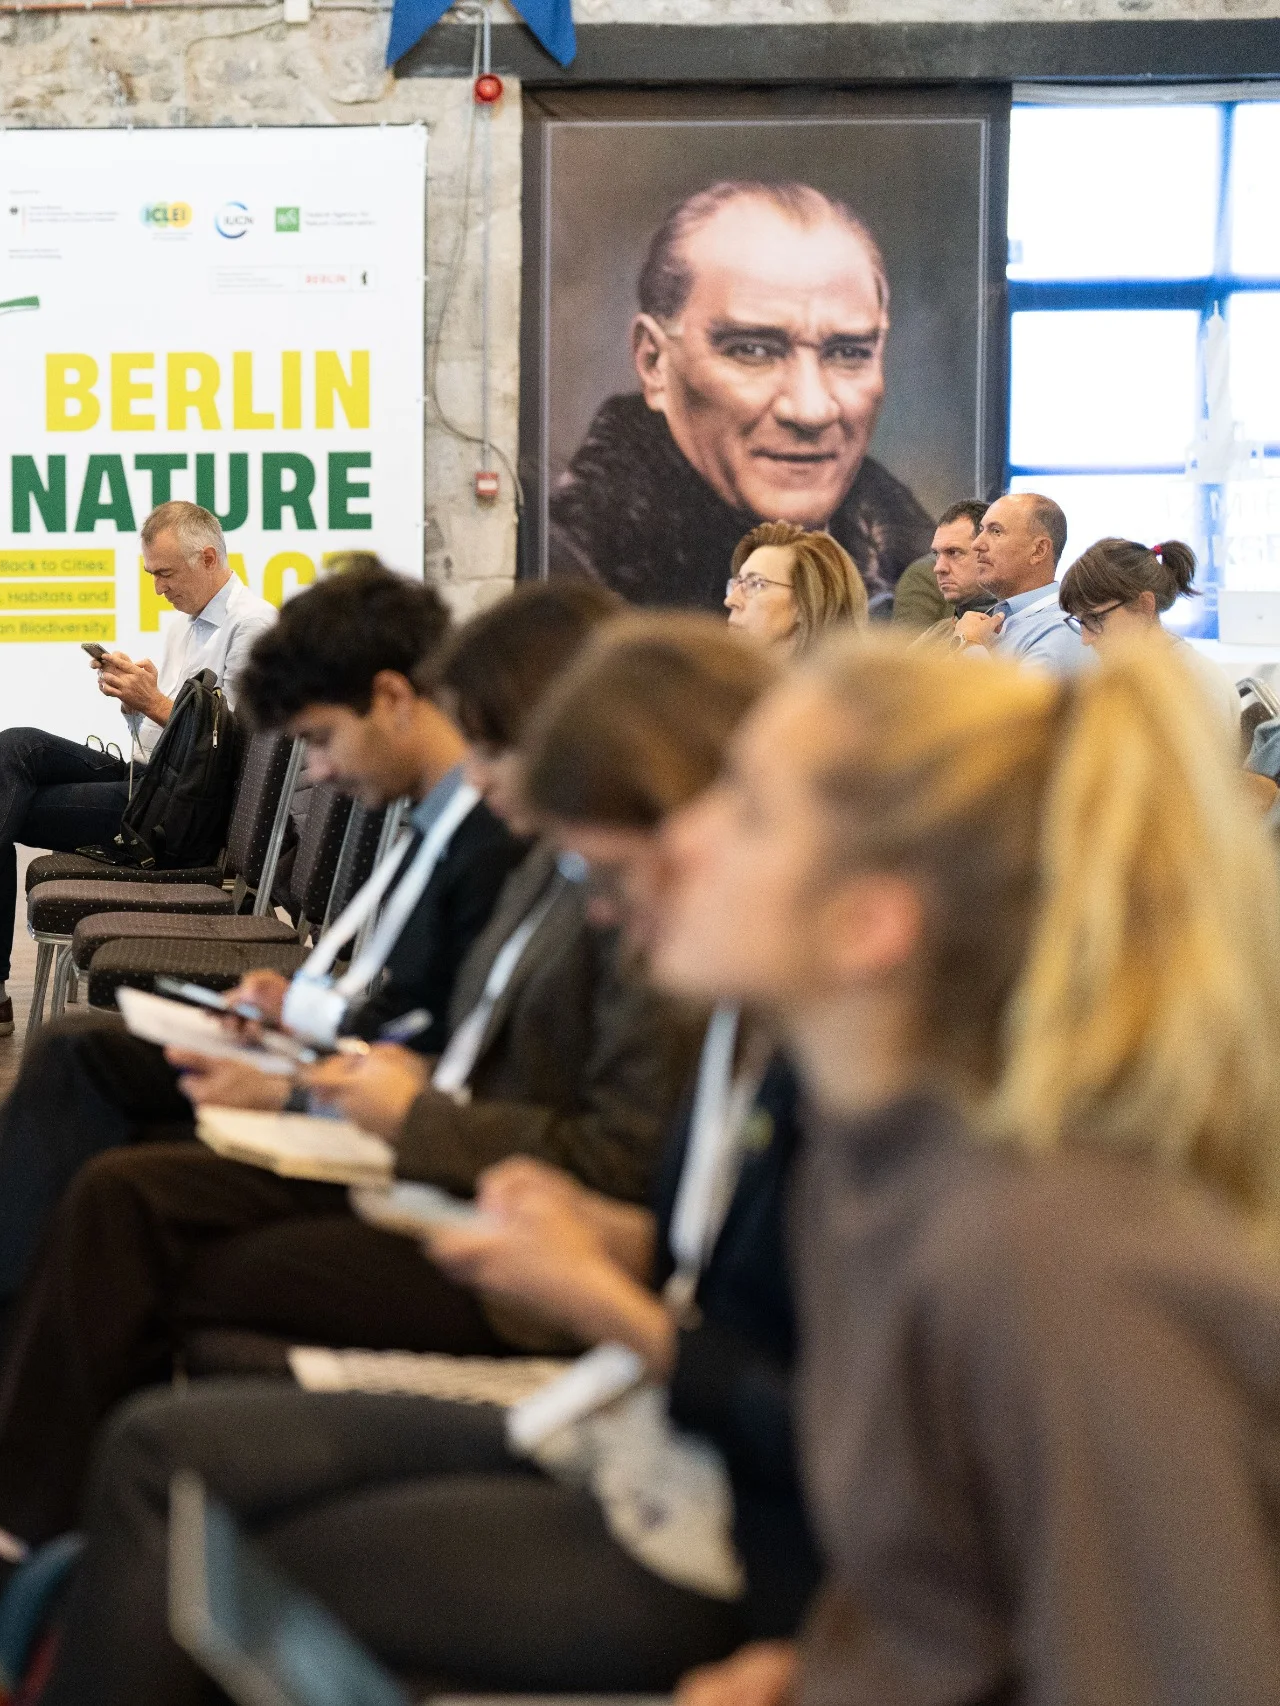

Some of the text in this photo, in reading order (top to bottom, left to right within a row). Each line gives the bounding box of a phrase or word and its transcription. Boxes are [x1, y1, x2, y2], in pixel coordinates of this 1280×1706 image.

[145, 208, 186, 222] ICLEI
[224, 215, 255, 226] IUCN
[45, 351, 371, 432] BERLIN
[12, 452, 371, 532] NATURE
[0, 559, 36, 571] Back
[41, 559, 56, 571] to
[60, 558, 106, 571] Cities:
[8, 590, 73, 602] Habitats
[78, 590, 110, 602] and
[19, 621, 109, 637] Biodiversity
